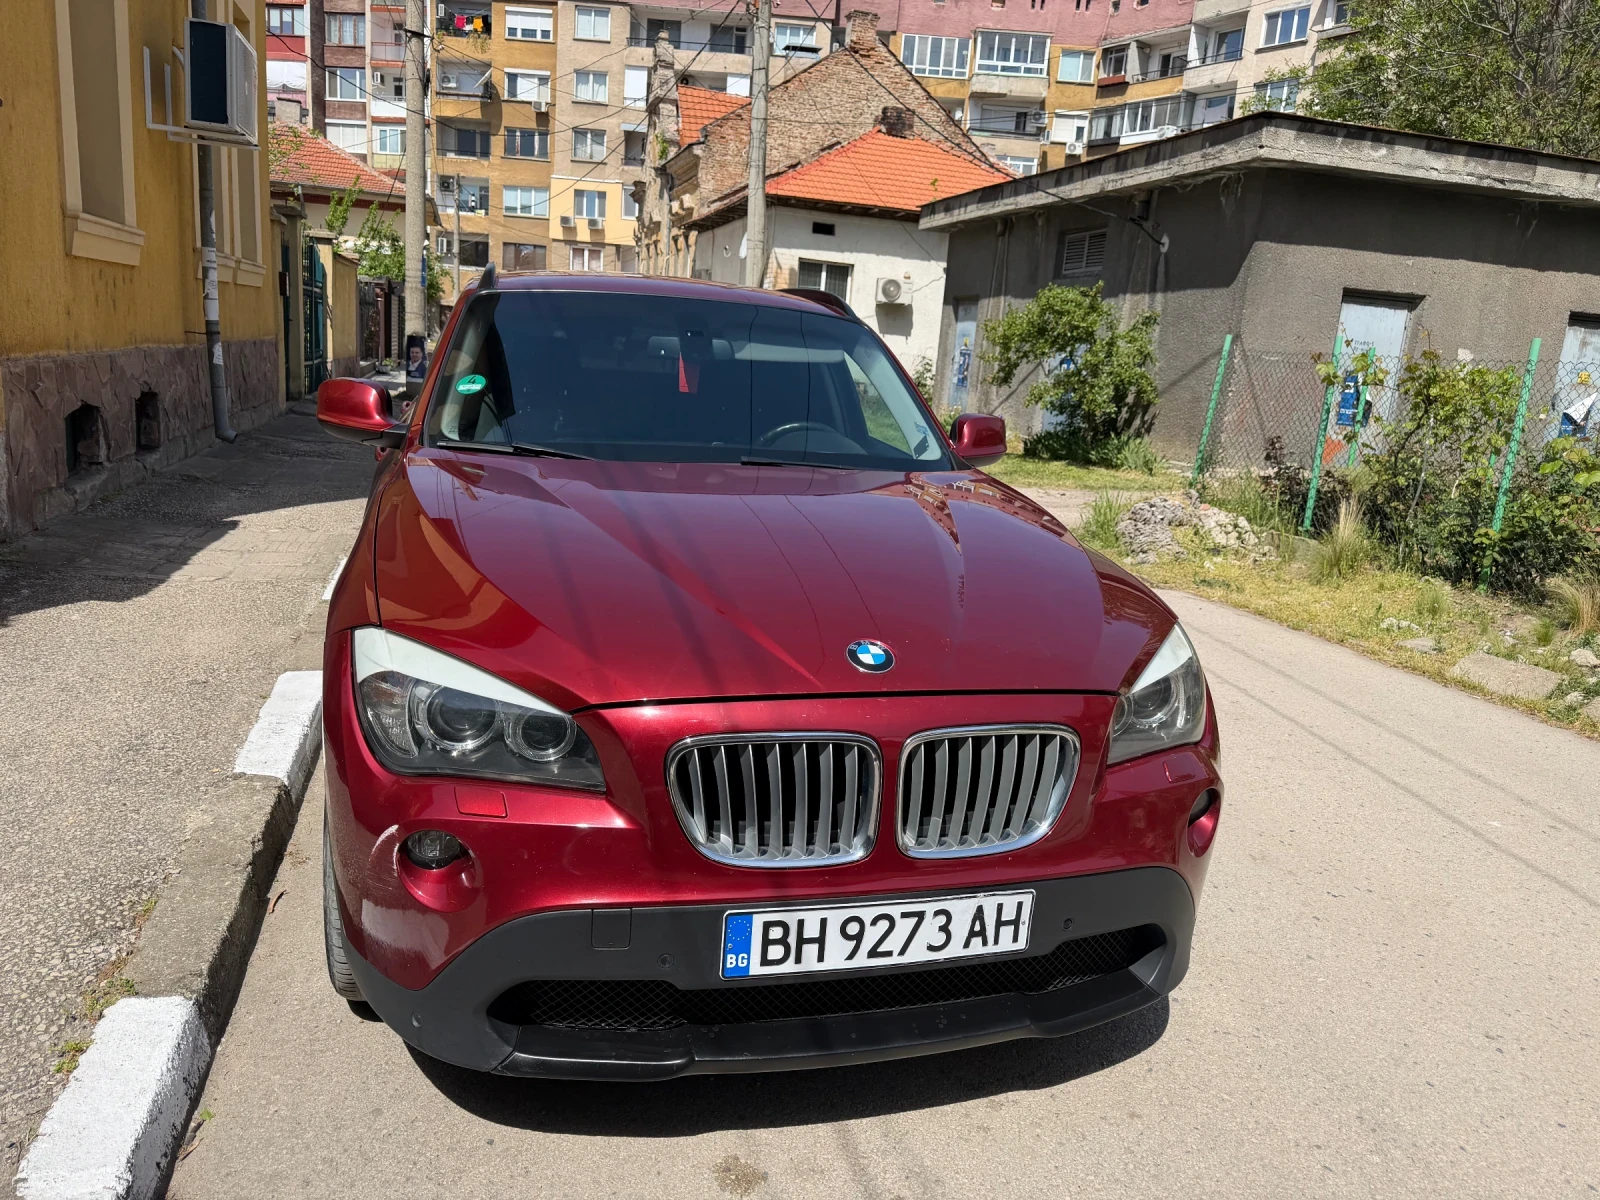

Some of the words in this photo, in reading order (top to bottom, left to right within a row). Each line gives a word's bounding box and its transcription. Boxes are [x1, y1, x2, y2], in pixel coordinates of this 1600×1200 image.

[468, 375, 476, 384] 4
[849, 640, 886, 650] BMW
[759, 917, 828, 967] BH
[839, 908, 953, 961] 9273
[962, 901, 1024, 949] AH
[726, 953, 748, 968] BG
